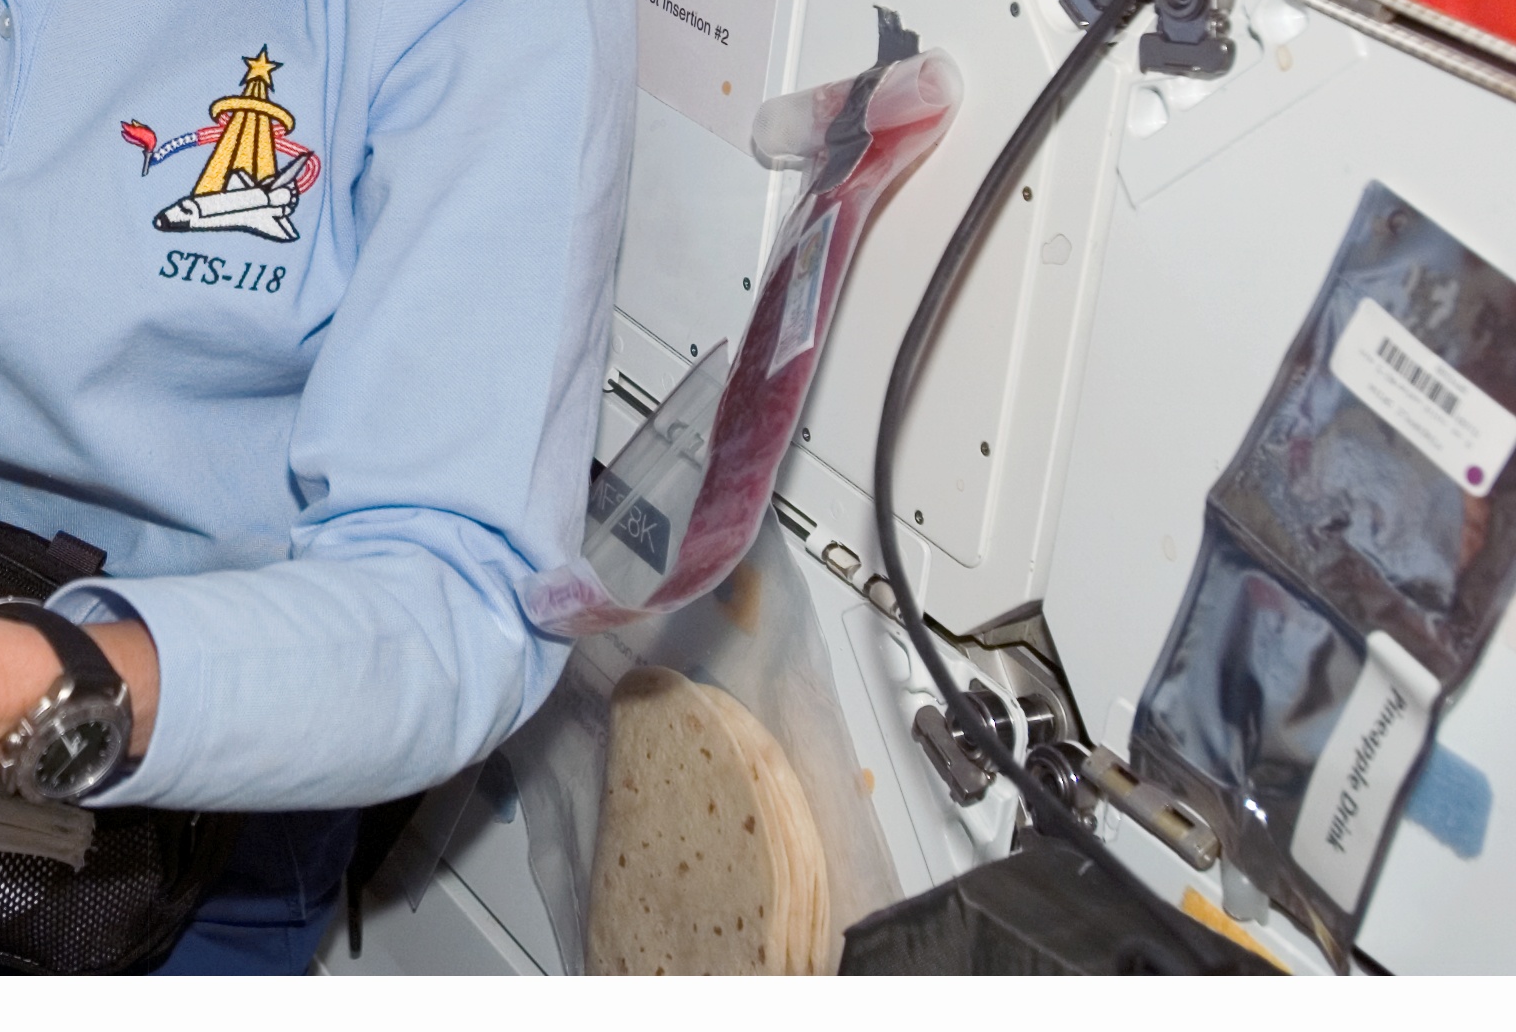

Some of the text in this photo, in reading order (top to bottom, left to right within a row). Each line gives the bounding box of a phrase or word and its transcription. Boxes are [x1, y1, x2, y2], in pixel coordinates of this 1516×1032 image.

[713, 24, 731, 47] #2
[159, 249, 287, 294] STS-118
[1325, 686, 1407, 854] Pineapple Drink
